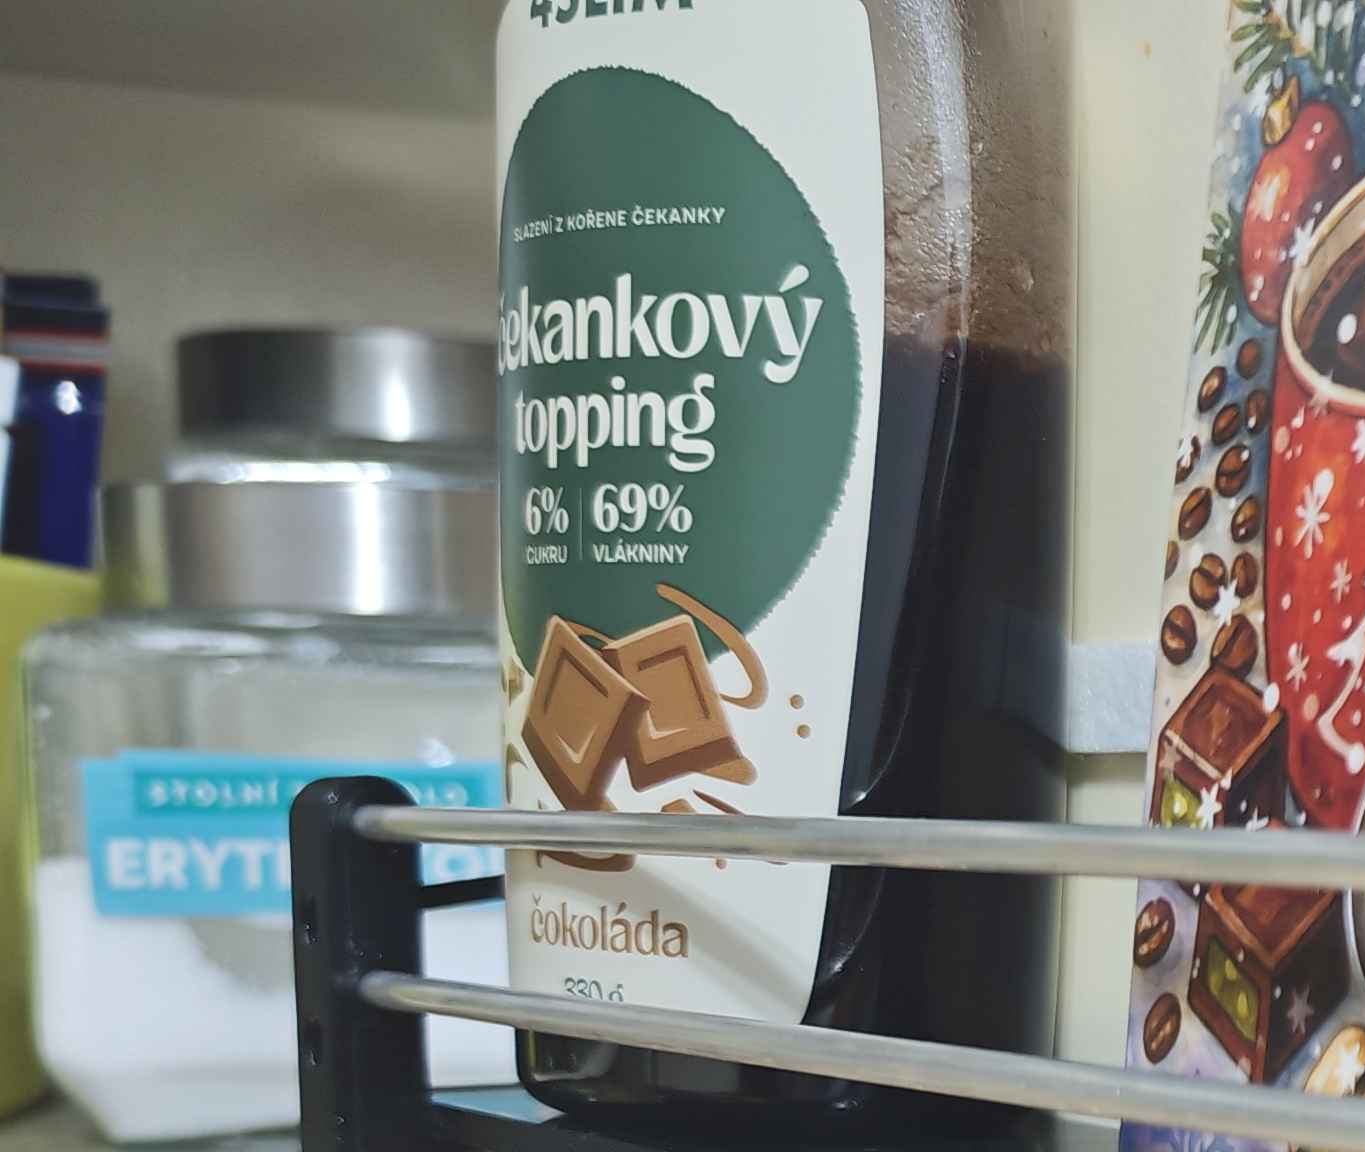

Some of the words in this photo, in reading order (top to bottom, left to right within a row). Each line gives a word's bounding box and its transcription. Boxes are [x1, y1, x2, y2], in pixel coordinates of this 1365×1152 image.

[555, 217, 564, 233] Z
[566, 209, 628, 231] KOŘENE
[631, 205, 726, 225] ČEKANKY
[515, 373, 716, 473] topping
[524, 486, 570, 535] 6%
[592, 482, 694, 534] 69%
[526, 543, 569, 565] CUKRU
[592, 538, 690, 564] VLÁKNINY
[530, 895, 690, 959] čokoláda
